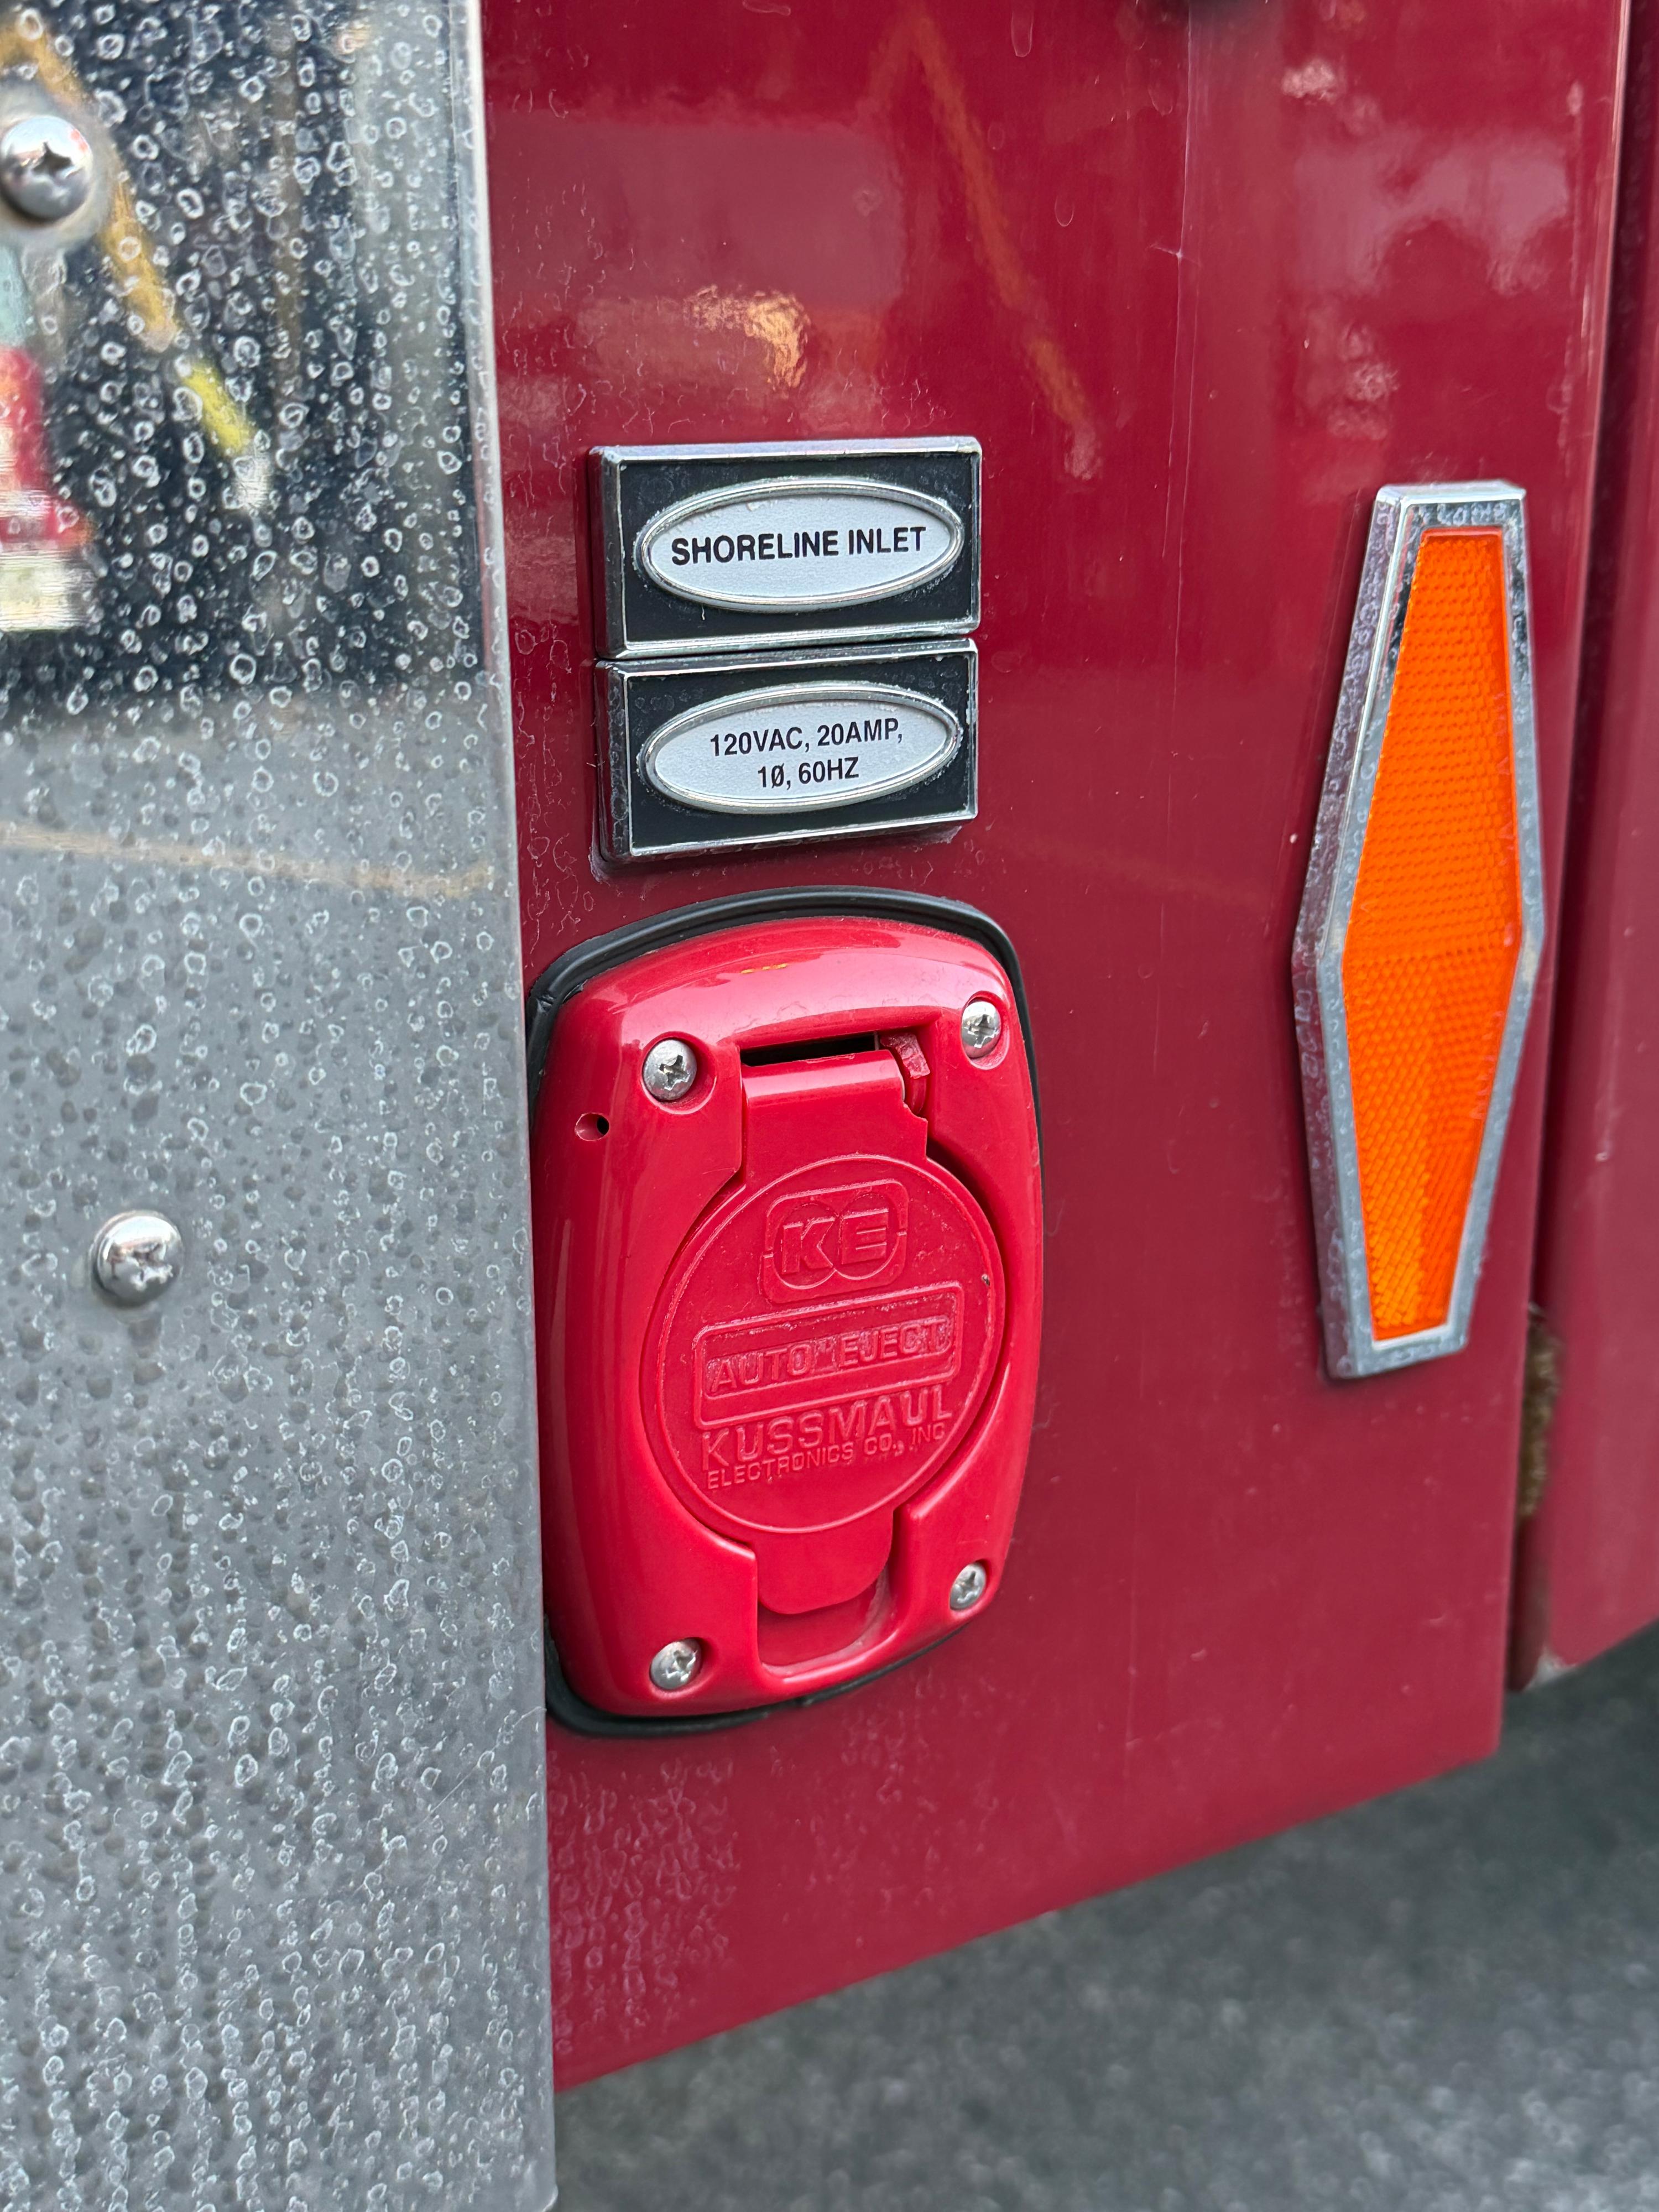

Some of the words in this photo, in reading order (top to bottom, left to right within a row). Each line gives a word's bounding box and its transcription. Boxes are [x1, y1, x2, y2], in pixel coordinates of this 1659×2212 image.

[671, 530, 839, 566] SHORELINE
[848, 526, 927, 555] INLET
[710, 727, 810, 757] 120VAC,
[817, 718, 903, 747] 20AMP,
[799, 756, 859, 784] 60HZ
[780, 1208, 889, 1275] KE
[711, 1344, 811, 1393] AUTO
[839, 1317, 948, 1367] EJECT
[702, 1385, 952, 1472] KUSSMAUL
[707, 1442, 854, 1490] ELECTRONICS
